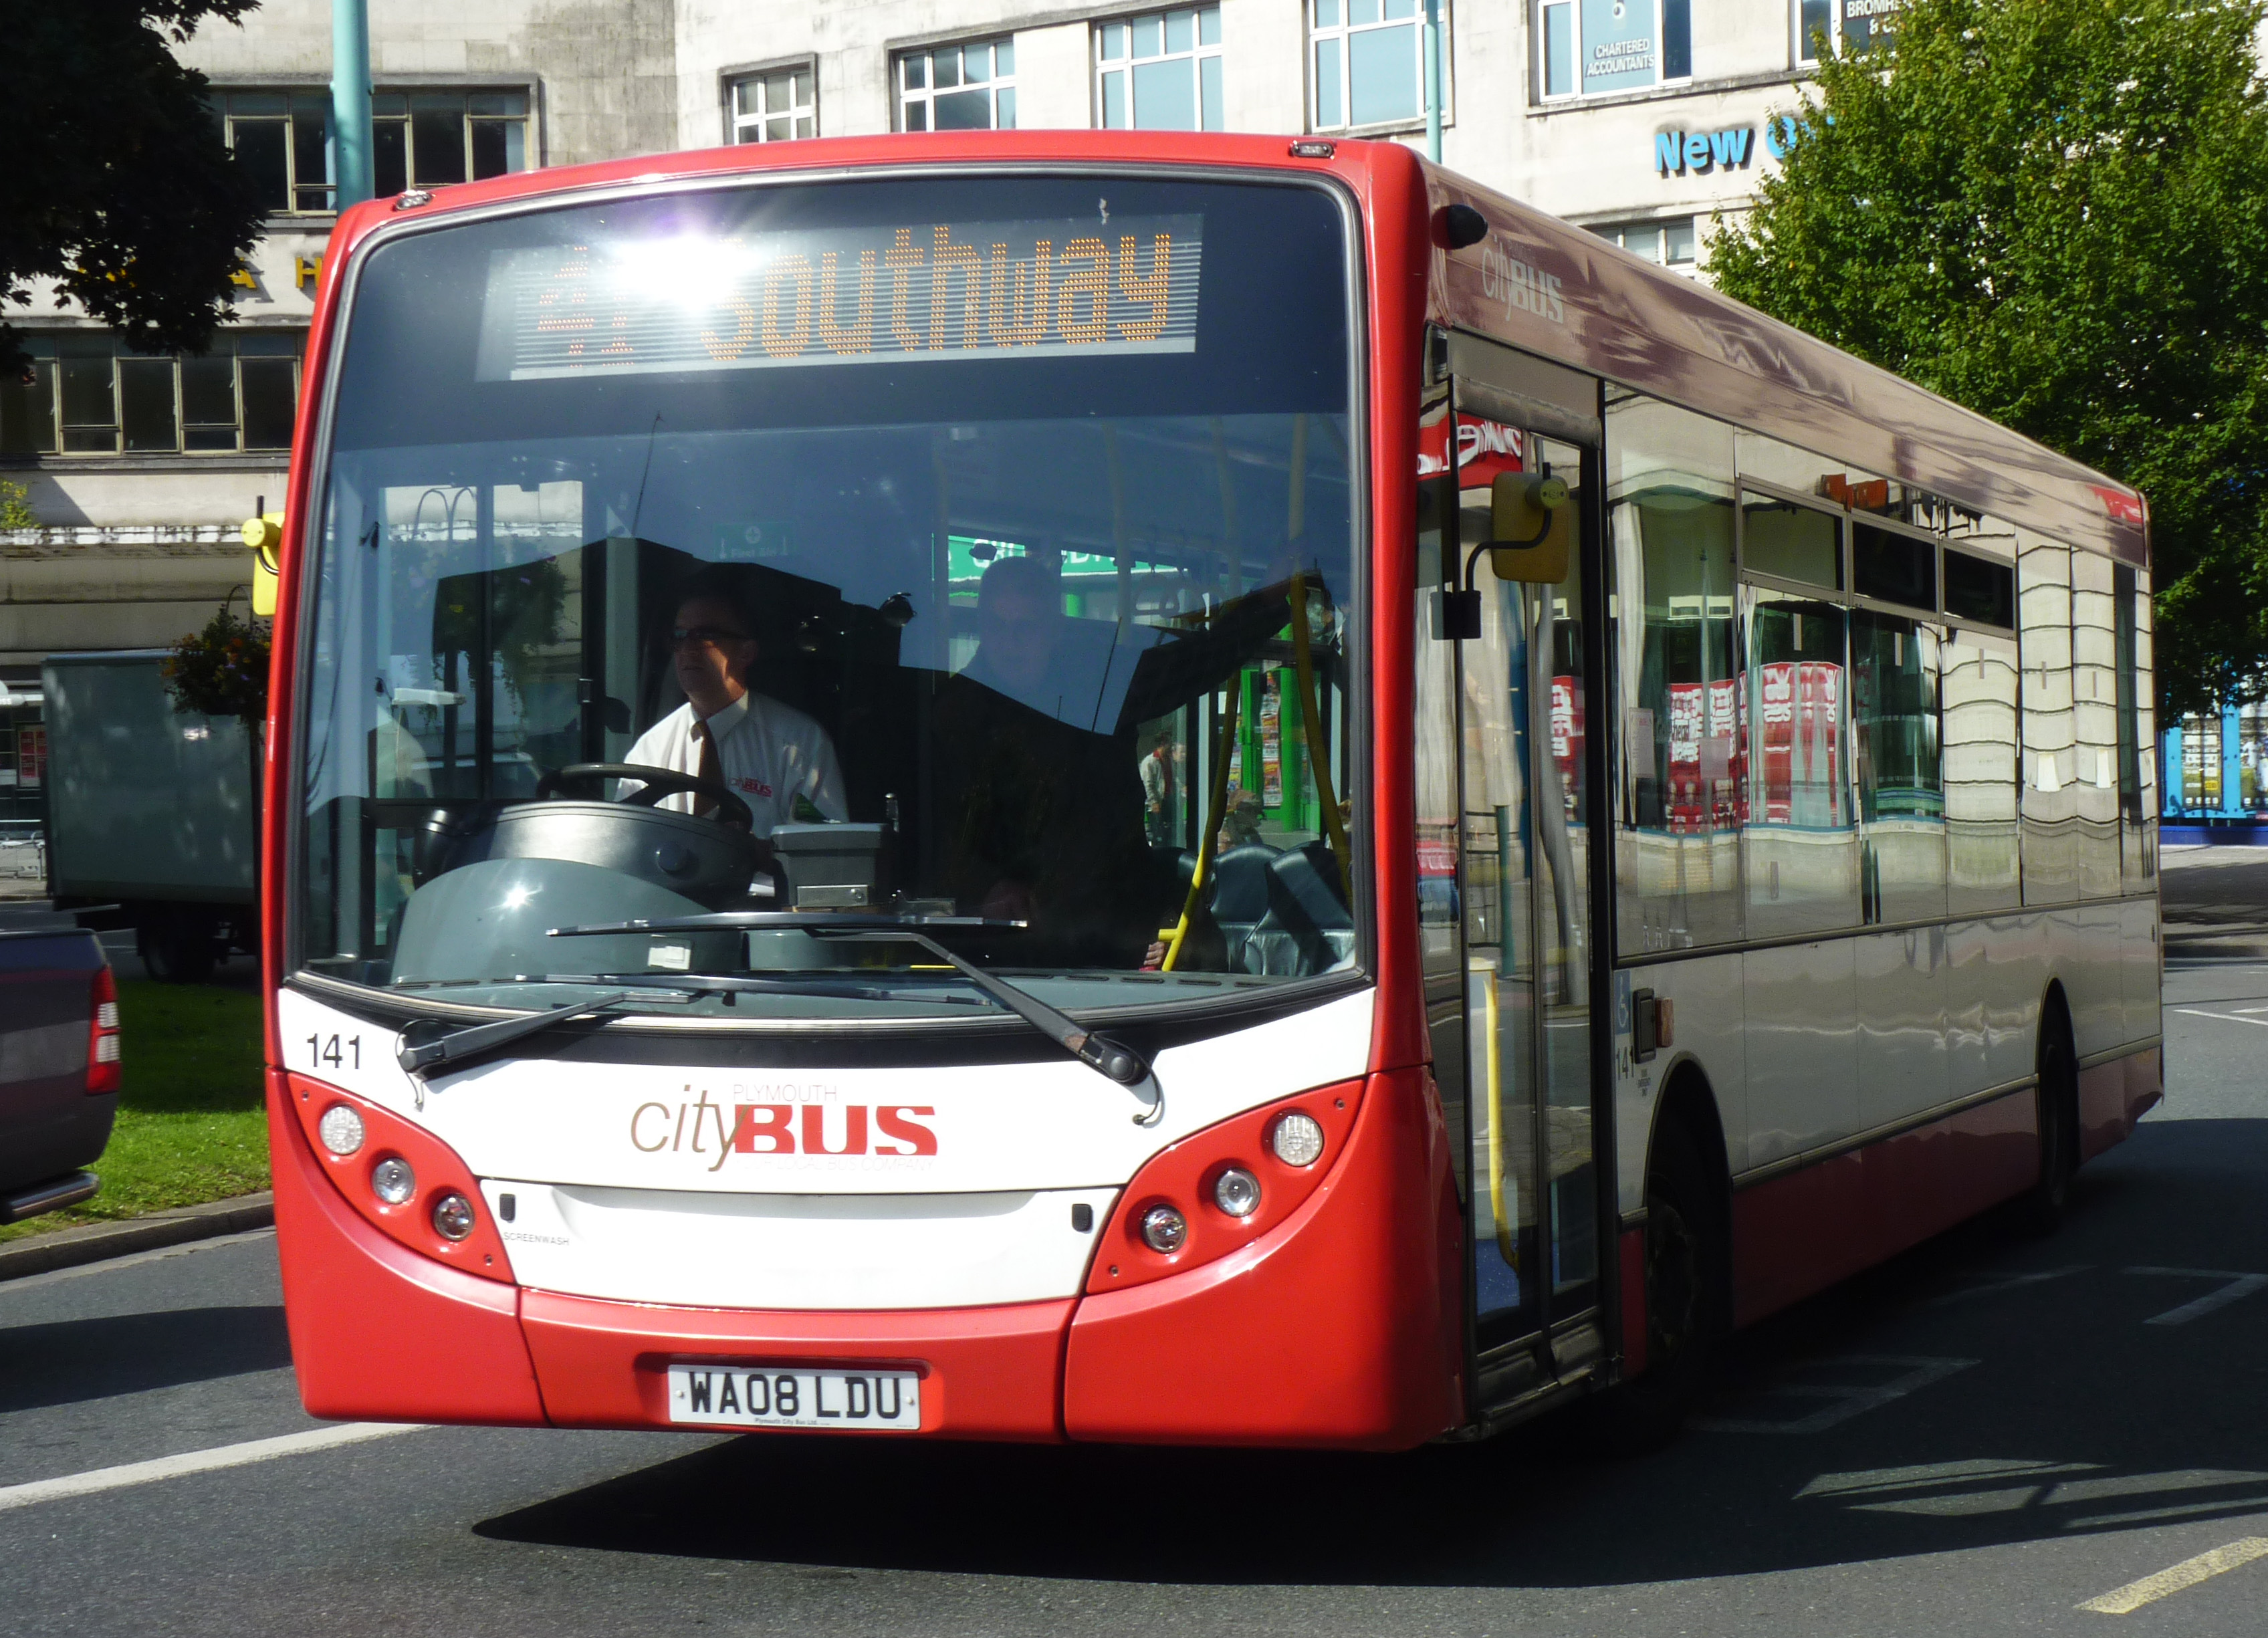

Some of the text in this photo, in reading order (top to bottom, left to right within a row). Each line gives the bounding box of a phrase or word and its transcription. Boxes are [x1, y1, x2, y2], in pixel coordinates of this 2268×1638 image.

[1595, 38, 1650, 59] CHARTERED
[1586, 54, 1655, 77] ACCOUNTANTS
[1655, 128, 1750, 172] New
[306, 1033, 360, 1070] 141
[1615, 1045, 1634, 1080] 141
[733, 1084, 837, 1102] PLYMOUTH
[777, 1156, 822, 1170] LOCAL
[827, 1157, 857, 1171] BUS
[861, 1157, 935, 1171] COMPANY
[503, 1232, 570, 1246] SCREENWASH
[689, 1371, 901, 1419] WA08 LDU
